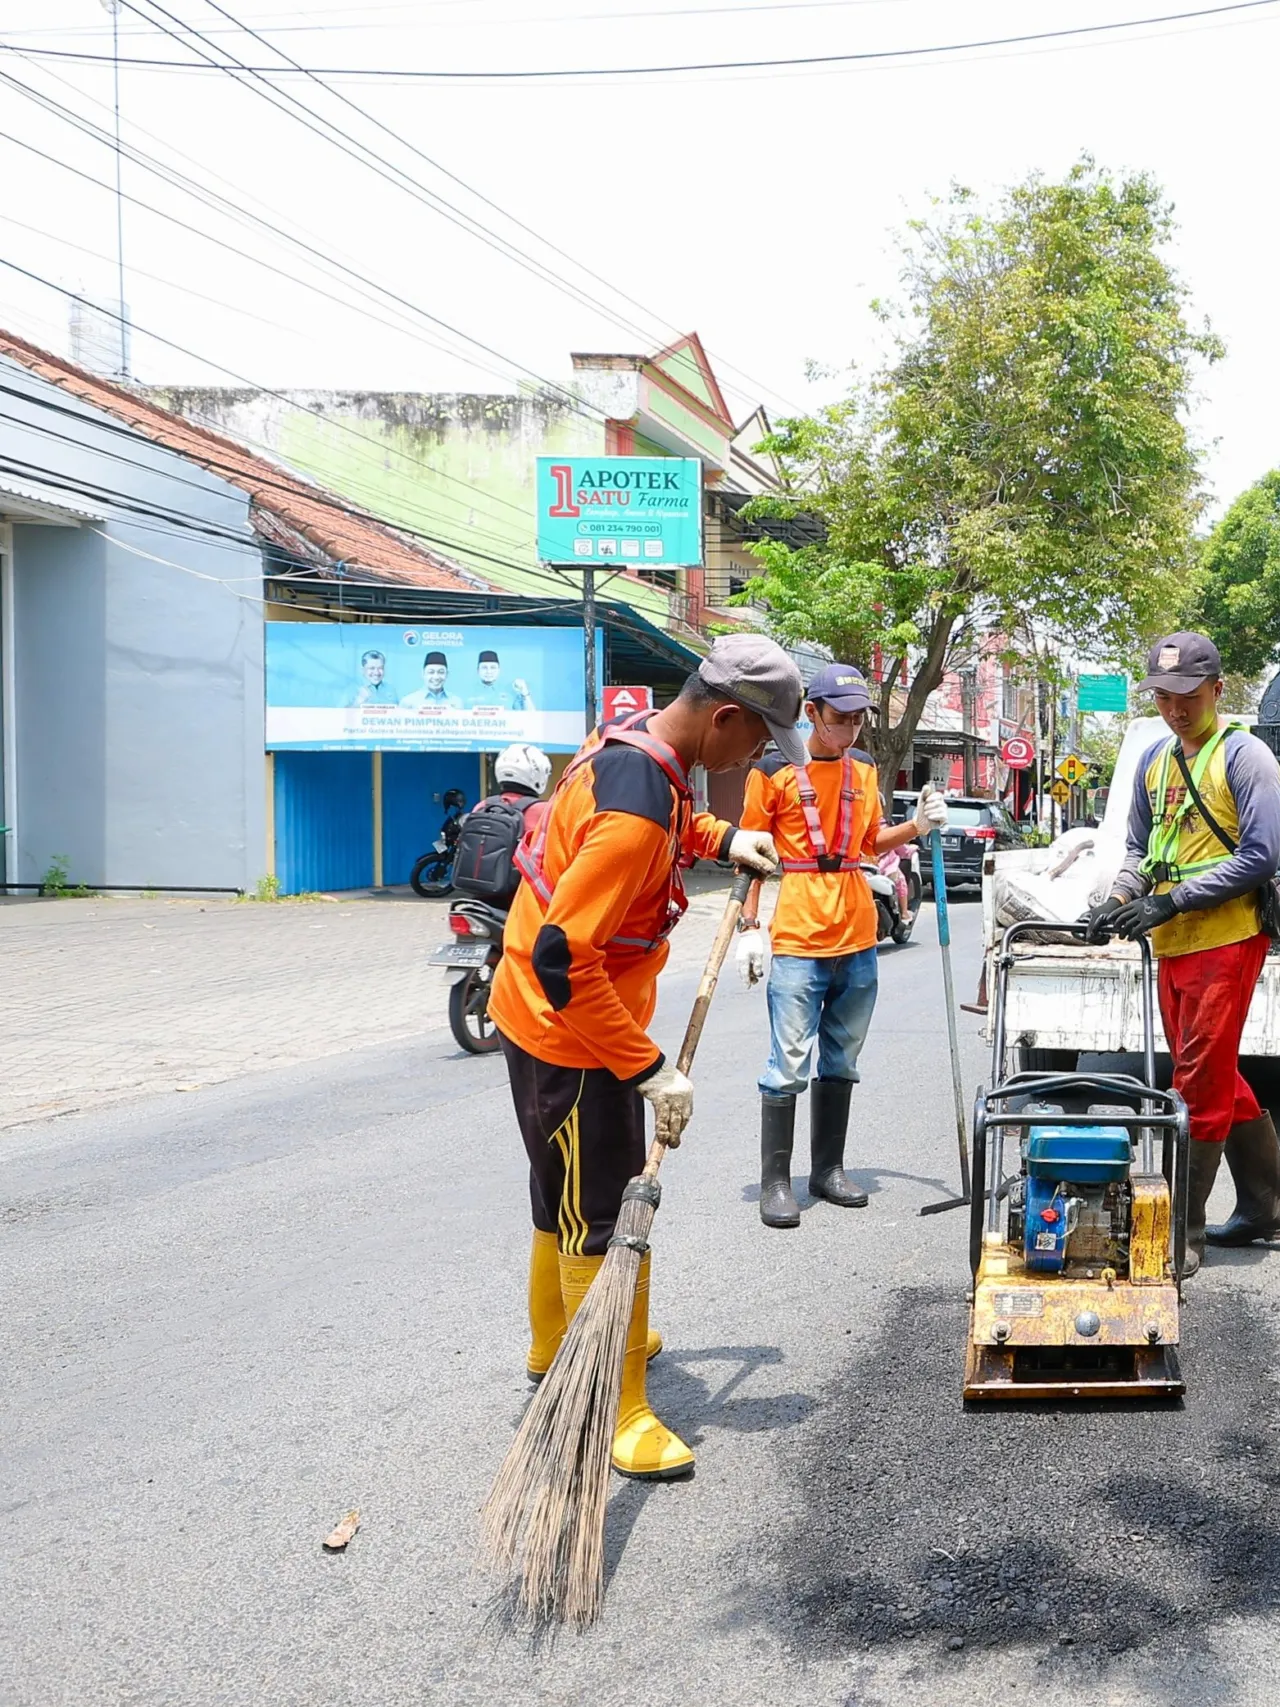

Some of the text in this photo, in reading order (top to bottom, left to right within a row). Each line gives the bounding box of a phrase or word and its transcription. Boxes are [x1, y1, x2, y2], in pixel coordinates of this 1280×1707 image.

[578, 470, 680, 490] APOTEK
[549, 466, 580, 517] 1
[577, 490, 689, 508] SATU Farma
[590, 524, 660, 533] 081 234 790 001
[422, 631, 464, 640] GELORA
[362, 717, 506, 727] DEWAN PIMPINAN DAERAH
